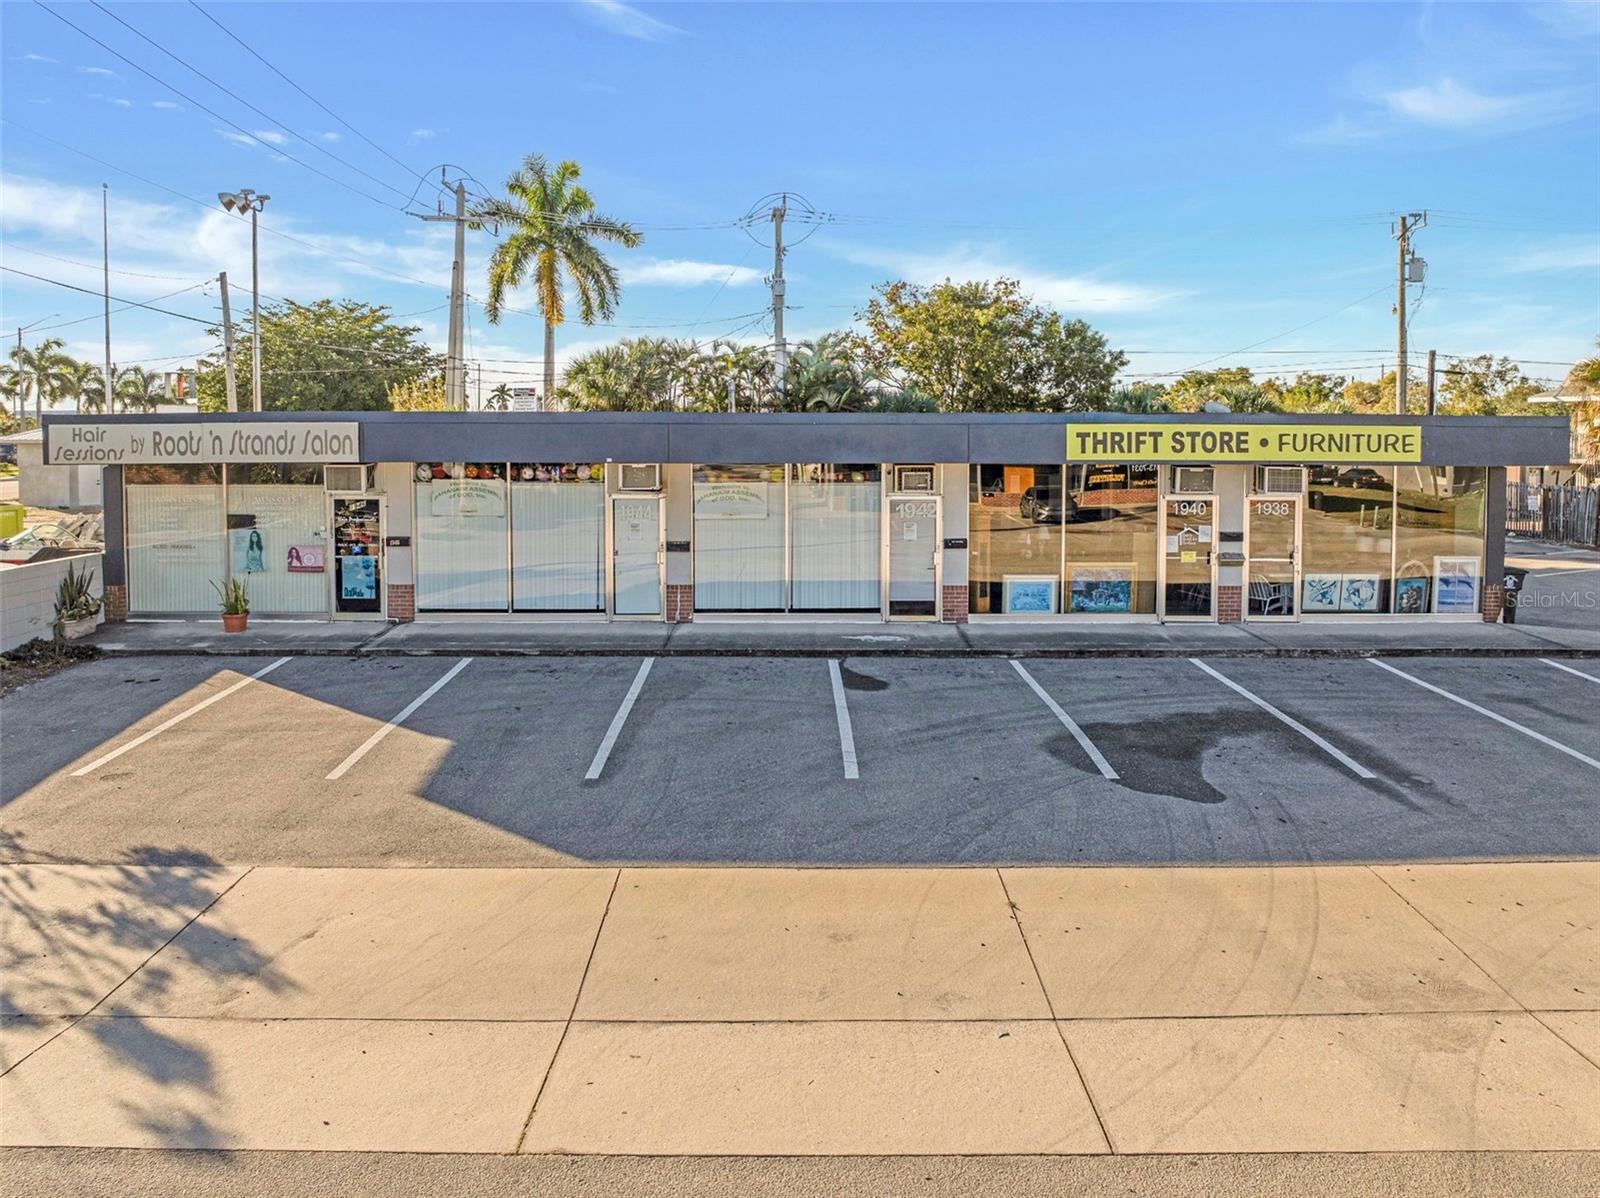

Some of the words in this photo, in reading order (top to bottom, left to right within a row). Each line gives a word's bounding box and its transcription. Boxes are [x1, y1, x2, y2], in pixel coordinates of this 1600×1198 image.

[72, 427, 106, 442] Hair
[131, 435, 145, 455] by
[153, 431, 202, 456] Roots
[209, 430, 223, 455] 'n
[229, 430, 296, 456] Strands
[302, 429, 353, 455] Salon
[1075, 431, 1163, 454] THRIFT
[1171, 431, 1249, 454] STORE
[1277, 432, 1415, 454] FURNITURE
[54, 445, 125, 461] Sessions
[621, 504, 653, 520] 1944
[896, 503, 936, 519] 1942
[1172, 502, 1206, 515] 1940
[1255, 502, 1289, 515] 1938
